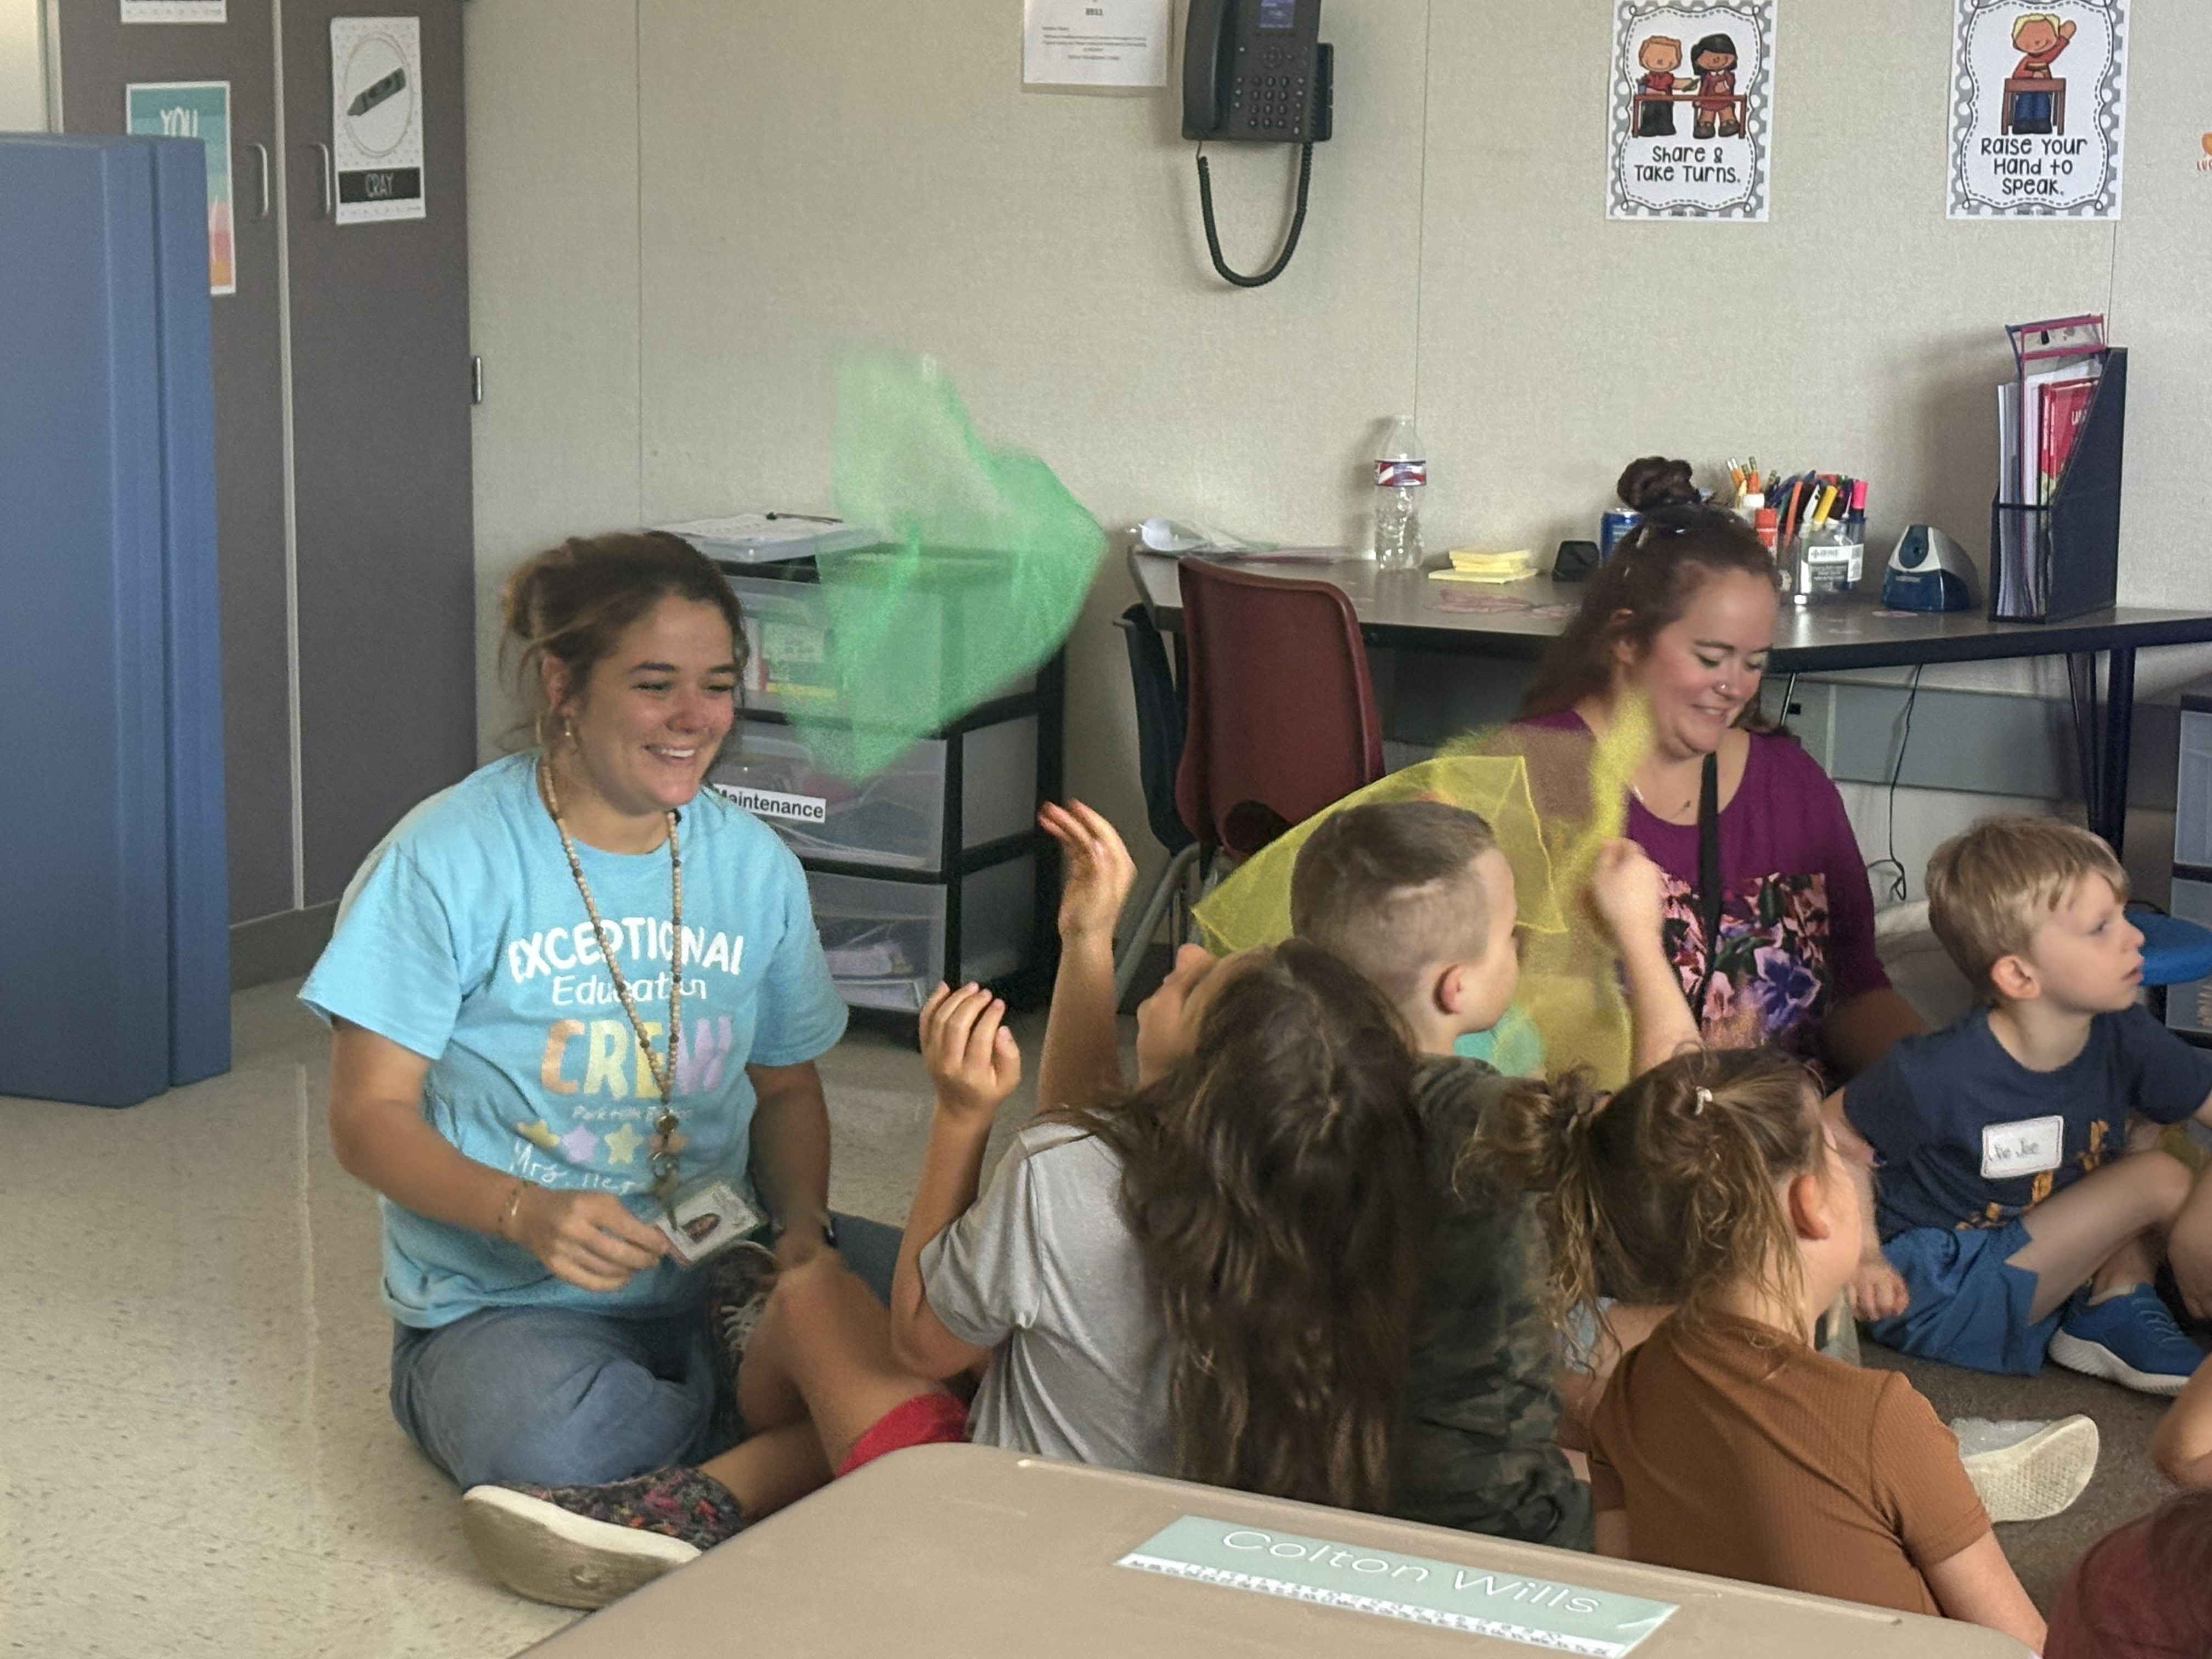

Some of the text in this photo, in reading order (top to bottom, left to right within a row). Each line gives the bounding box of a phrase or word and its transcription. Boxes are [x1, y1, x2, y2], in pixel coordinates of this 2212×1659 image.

[1652, 145, 1723, 163] Share &
[1981, 138, 2087, 155] Raise Your
[1634, 165, 1741, 183] Take Turns.
[1994, 157, 2073, 175] Hand to
[552, 971, 707, 1006] Eduaton
[540, 1016, 732, 1099] CREW
[1222, 1531, 1600, 1613] Colton Wills
